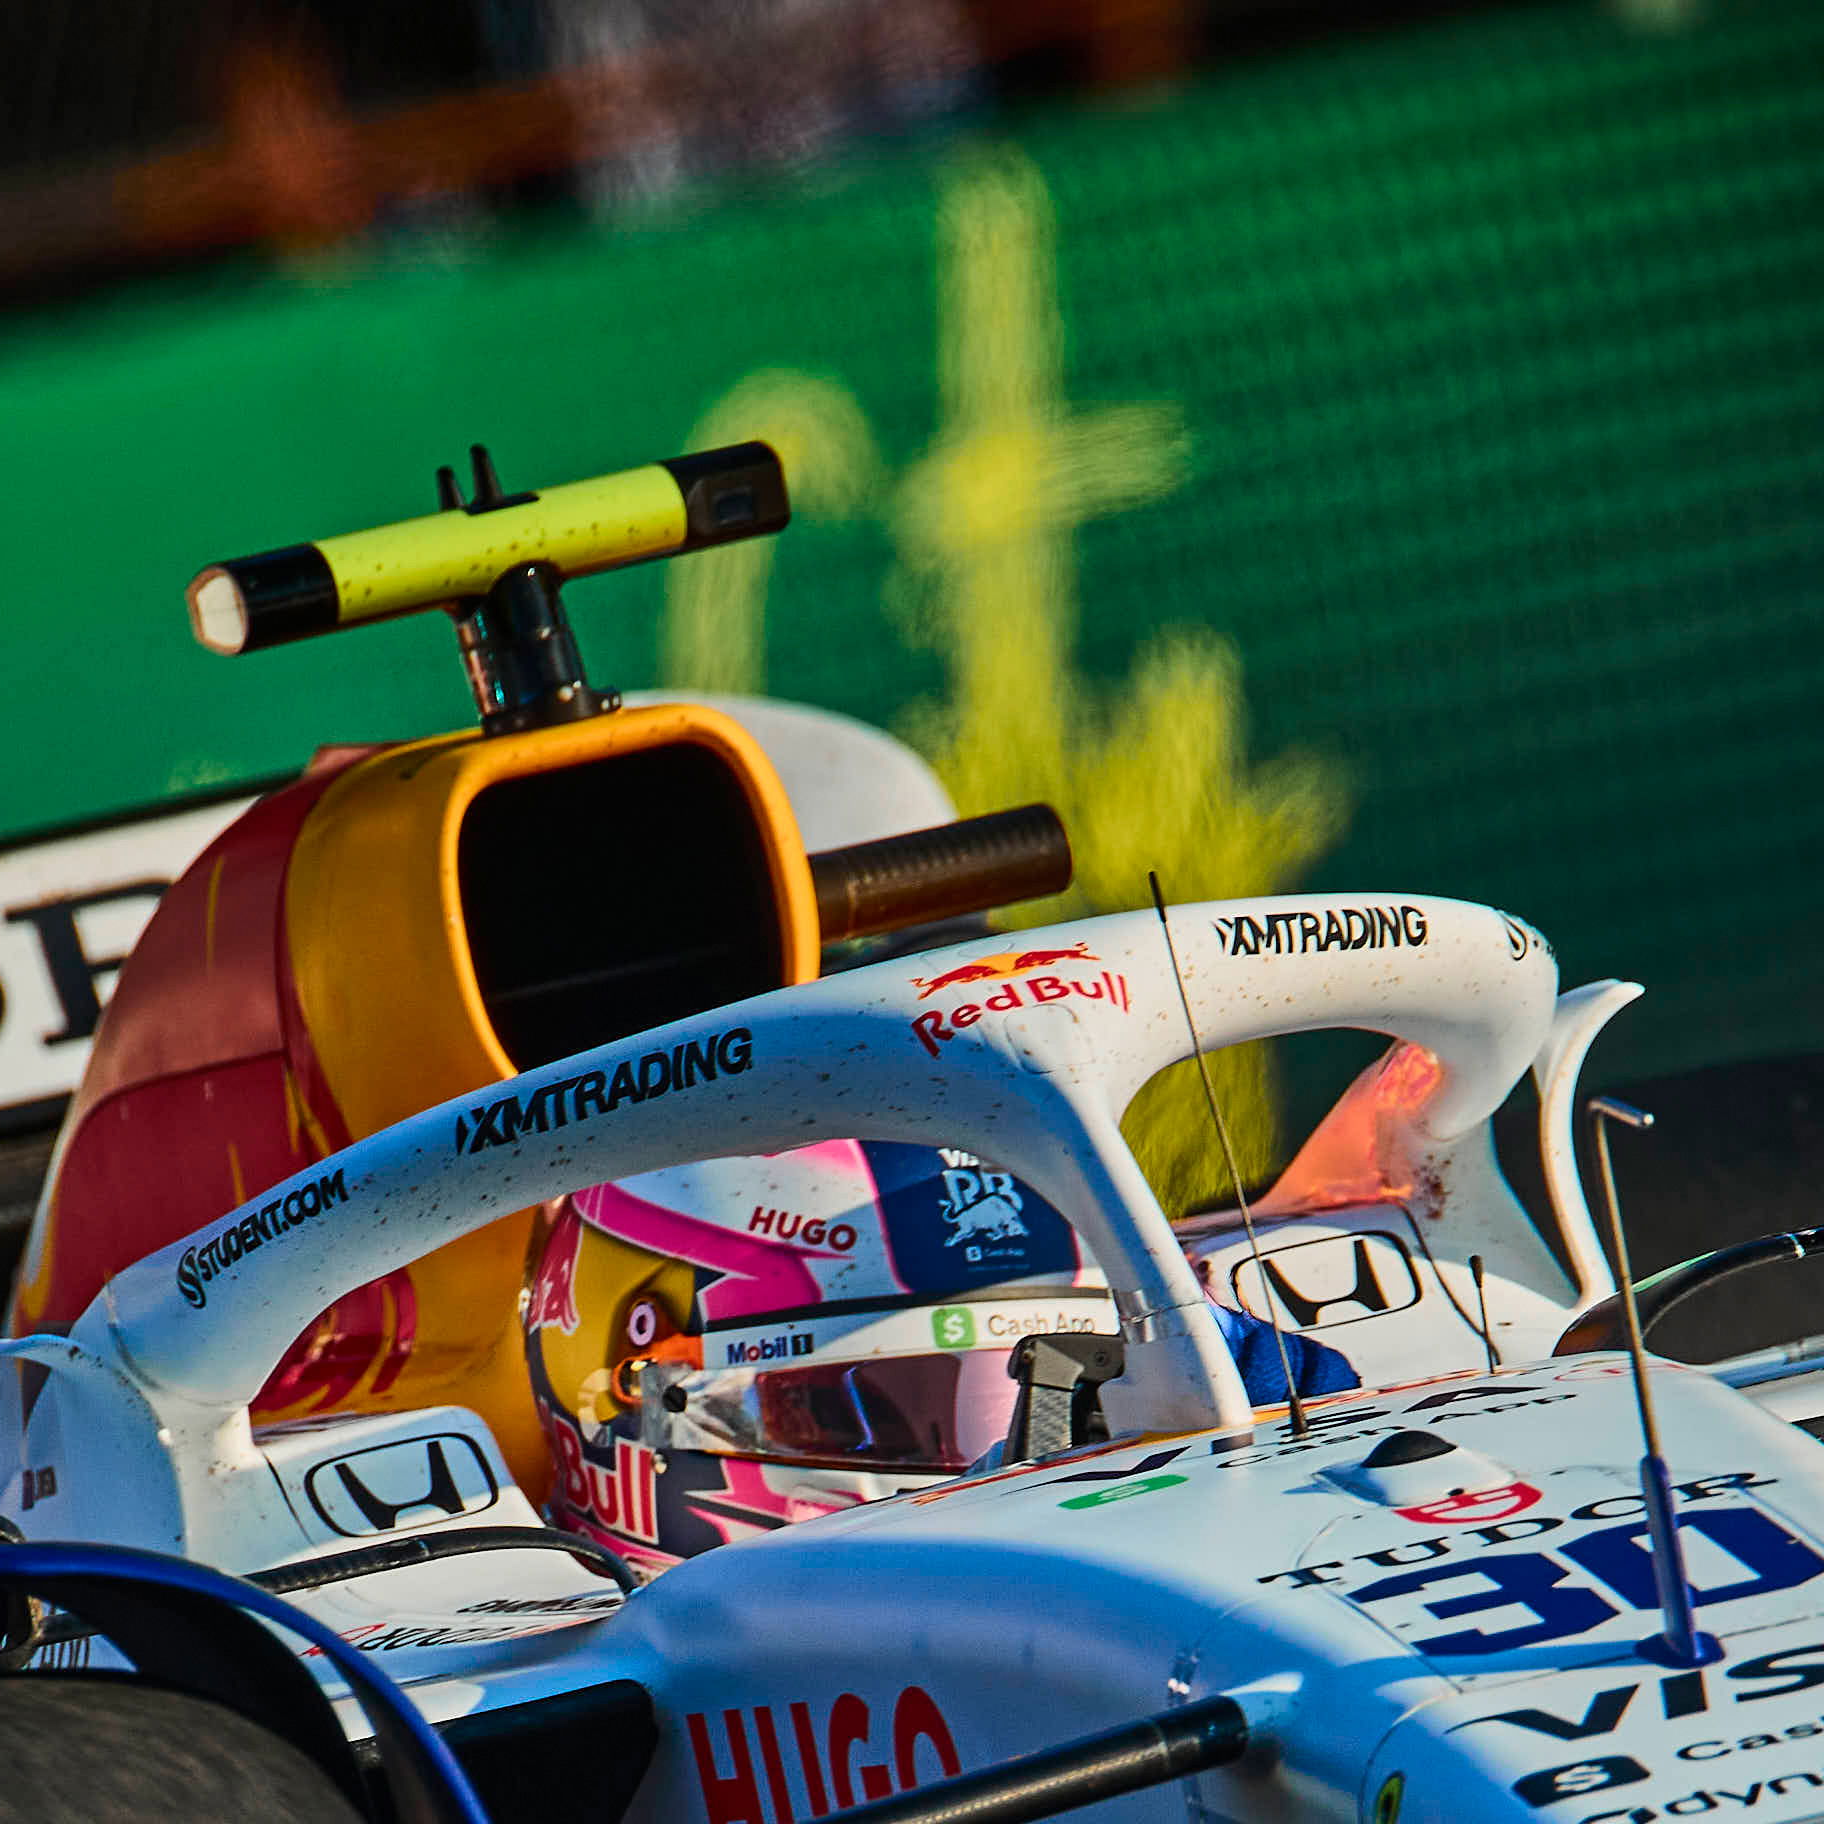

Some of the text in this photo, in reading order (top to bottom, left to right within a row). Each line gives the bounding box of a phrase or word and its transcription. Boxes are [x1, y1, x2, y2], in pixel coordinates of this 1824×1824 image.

[1213, 905, 1427, 957] XMTRADING
[911, 970, 1129, 1058] Red Bull
[454, 1027, 753, 1155] XMTRADING
[199, 1167, 349, 1283] STUDENT.COM
[748, 1205, 858, 1252] HUGO
[727, 1336, 788, 1366] Mobil
[988, 1312, 1050, 1336] Cash
[552, 1414, 660, 1541] Bull
[1258, 1471, 1779, 1590] TUDOR
